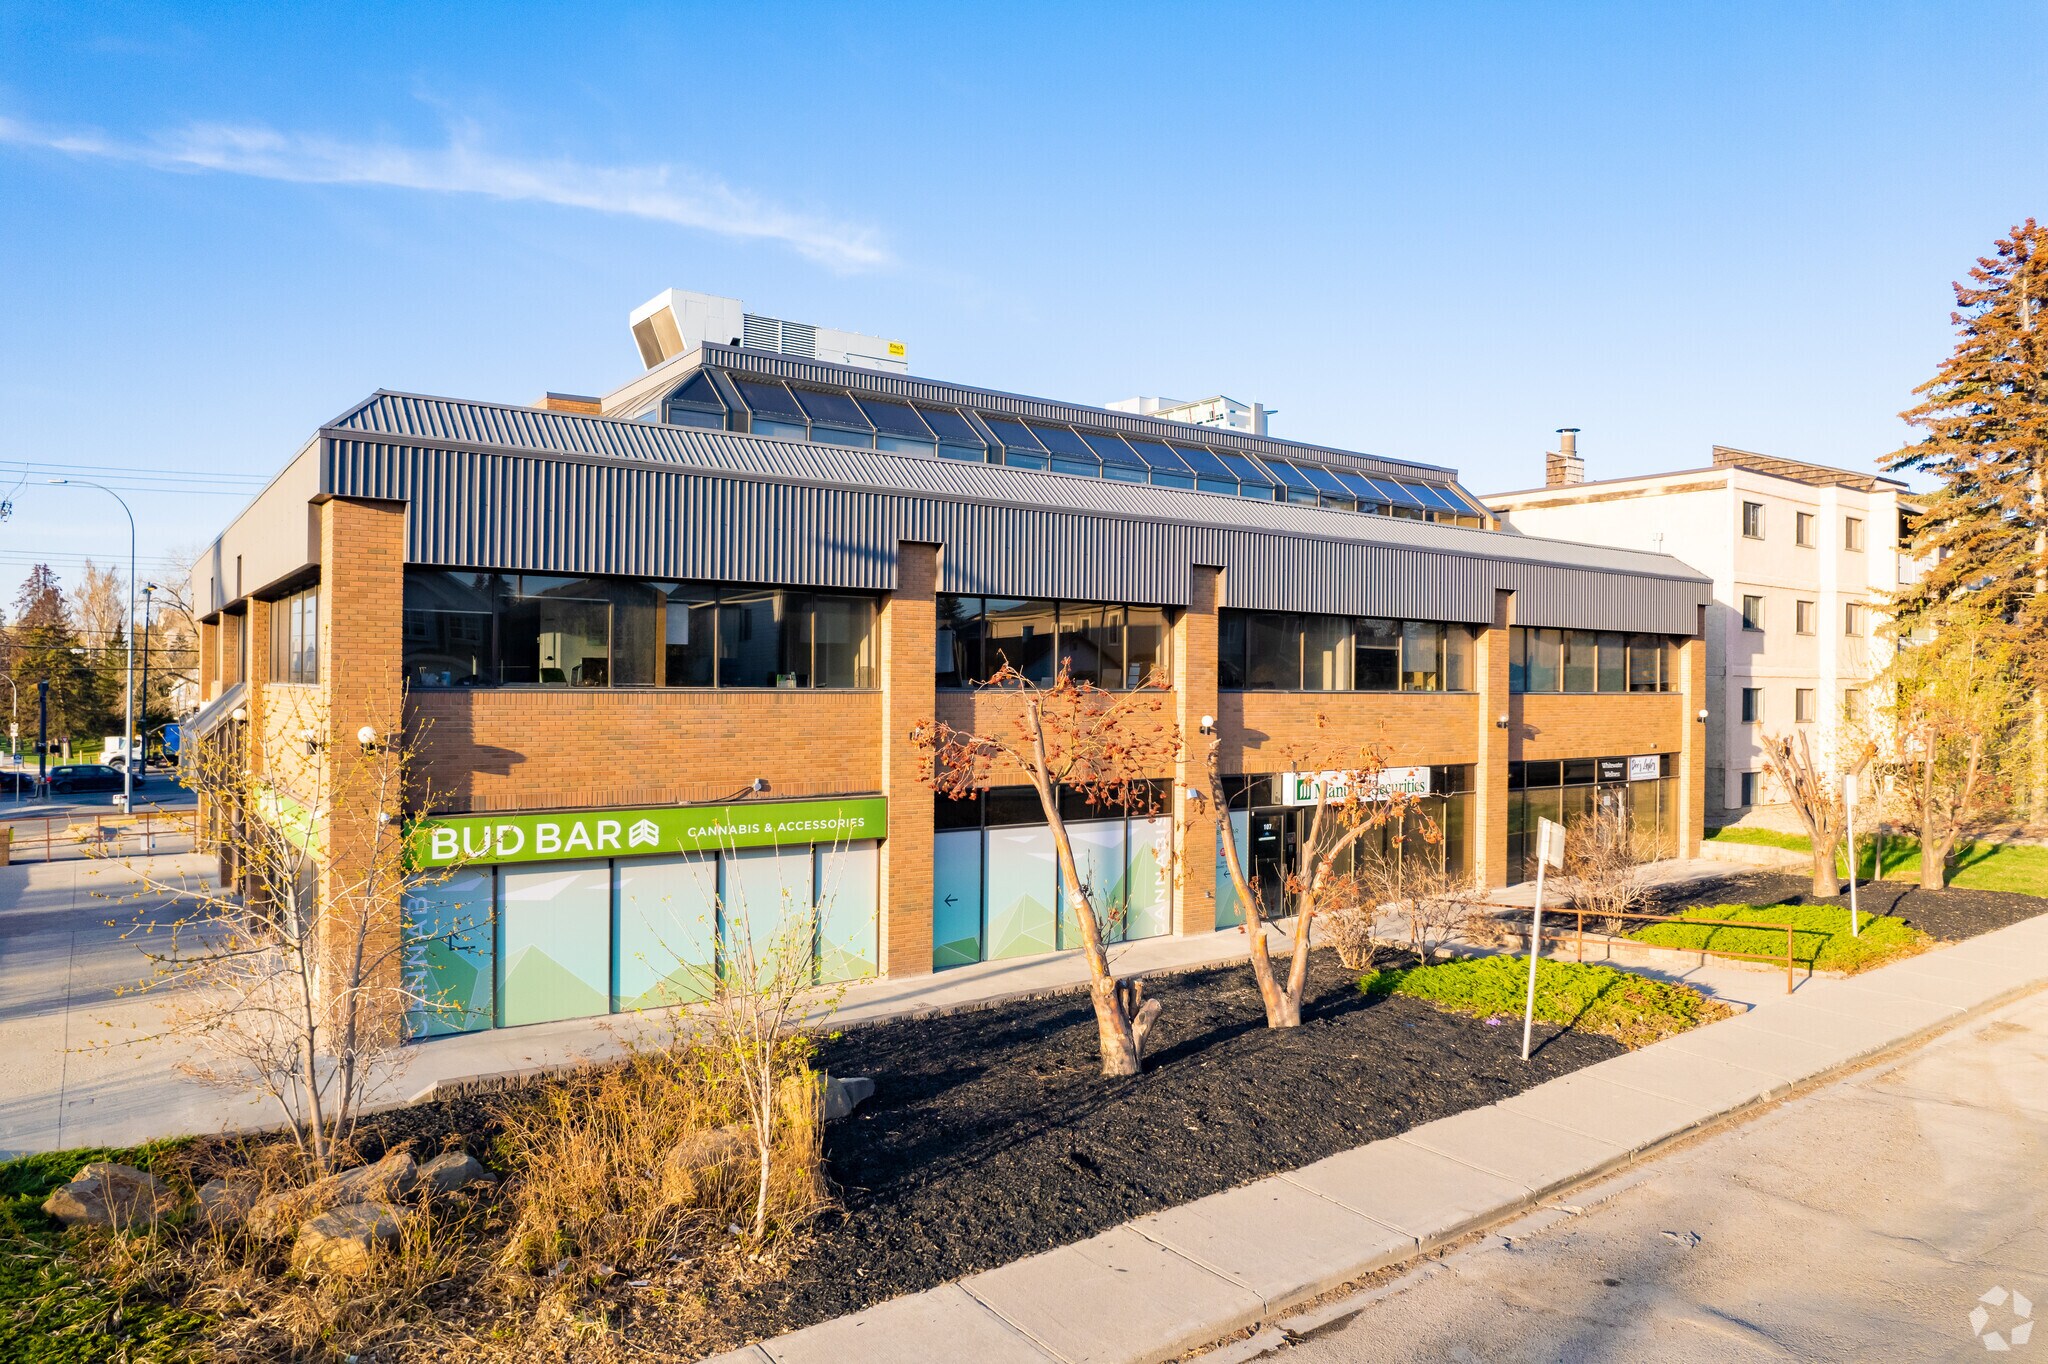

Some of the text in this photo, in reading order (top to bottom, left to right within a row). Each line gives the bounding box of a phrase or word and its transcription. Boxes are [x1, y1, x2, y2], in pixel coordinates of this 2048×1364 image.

[431, 820, 622, 860] BUD BAR
[687, 817, 866, 838] CANNABIS & ACCESSORIES
[1154, 817, 1166, 936] CANNABIS
